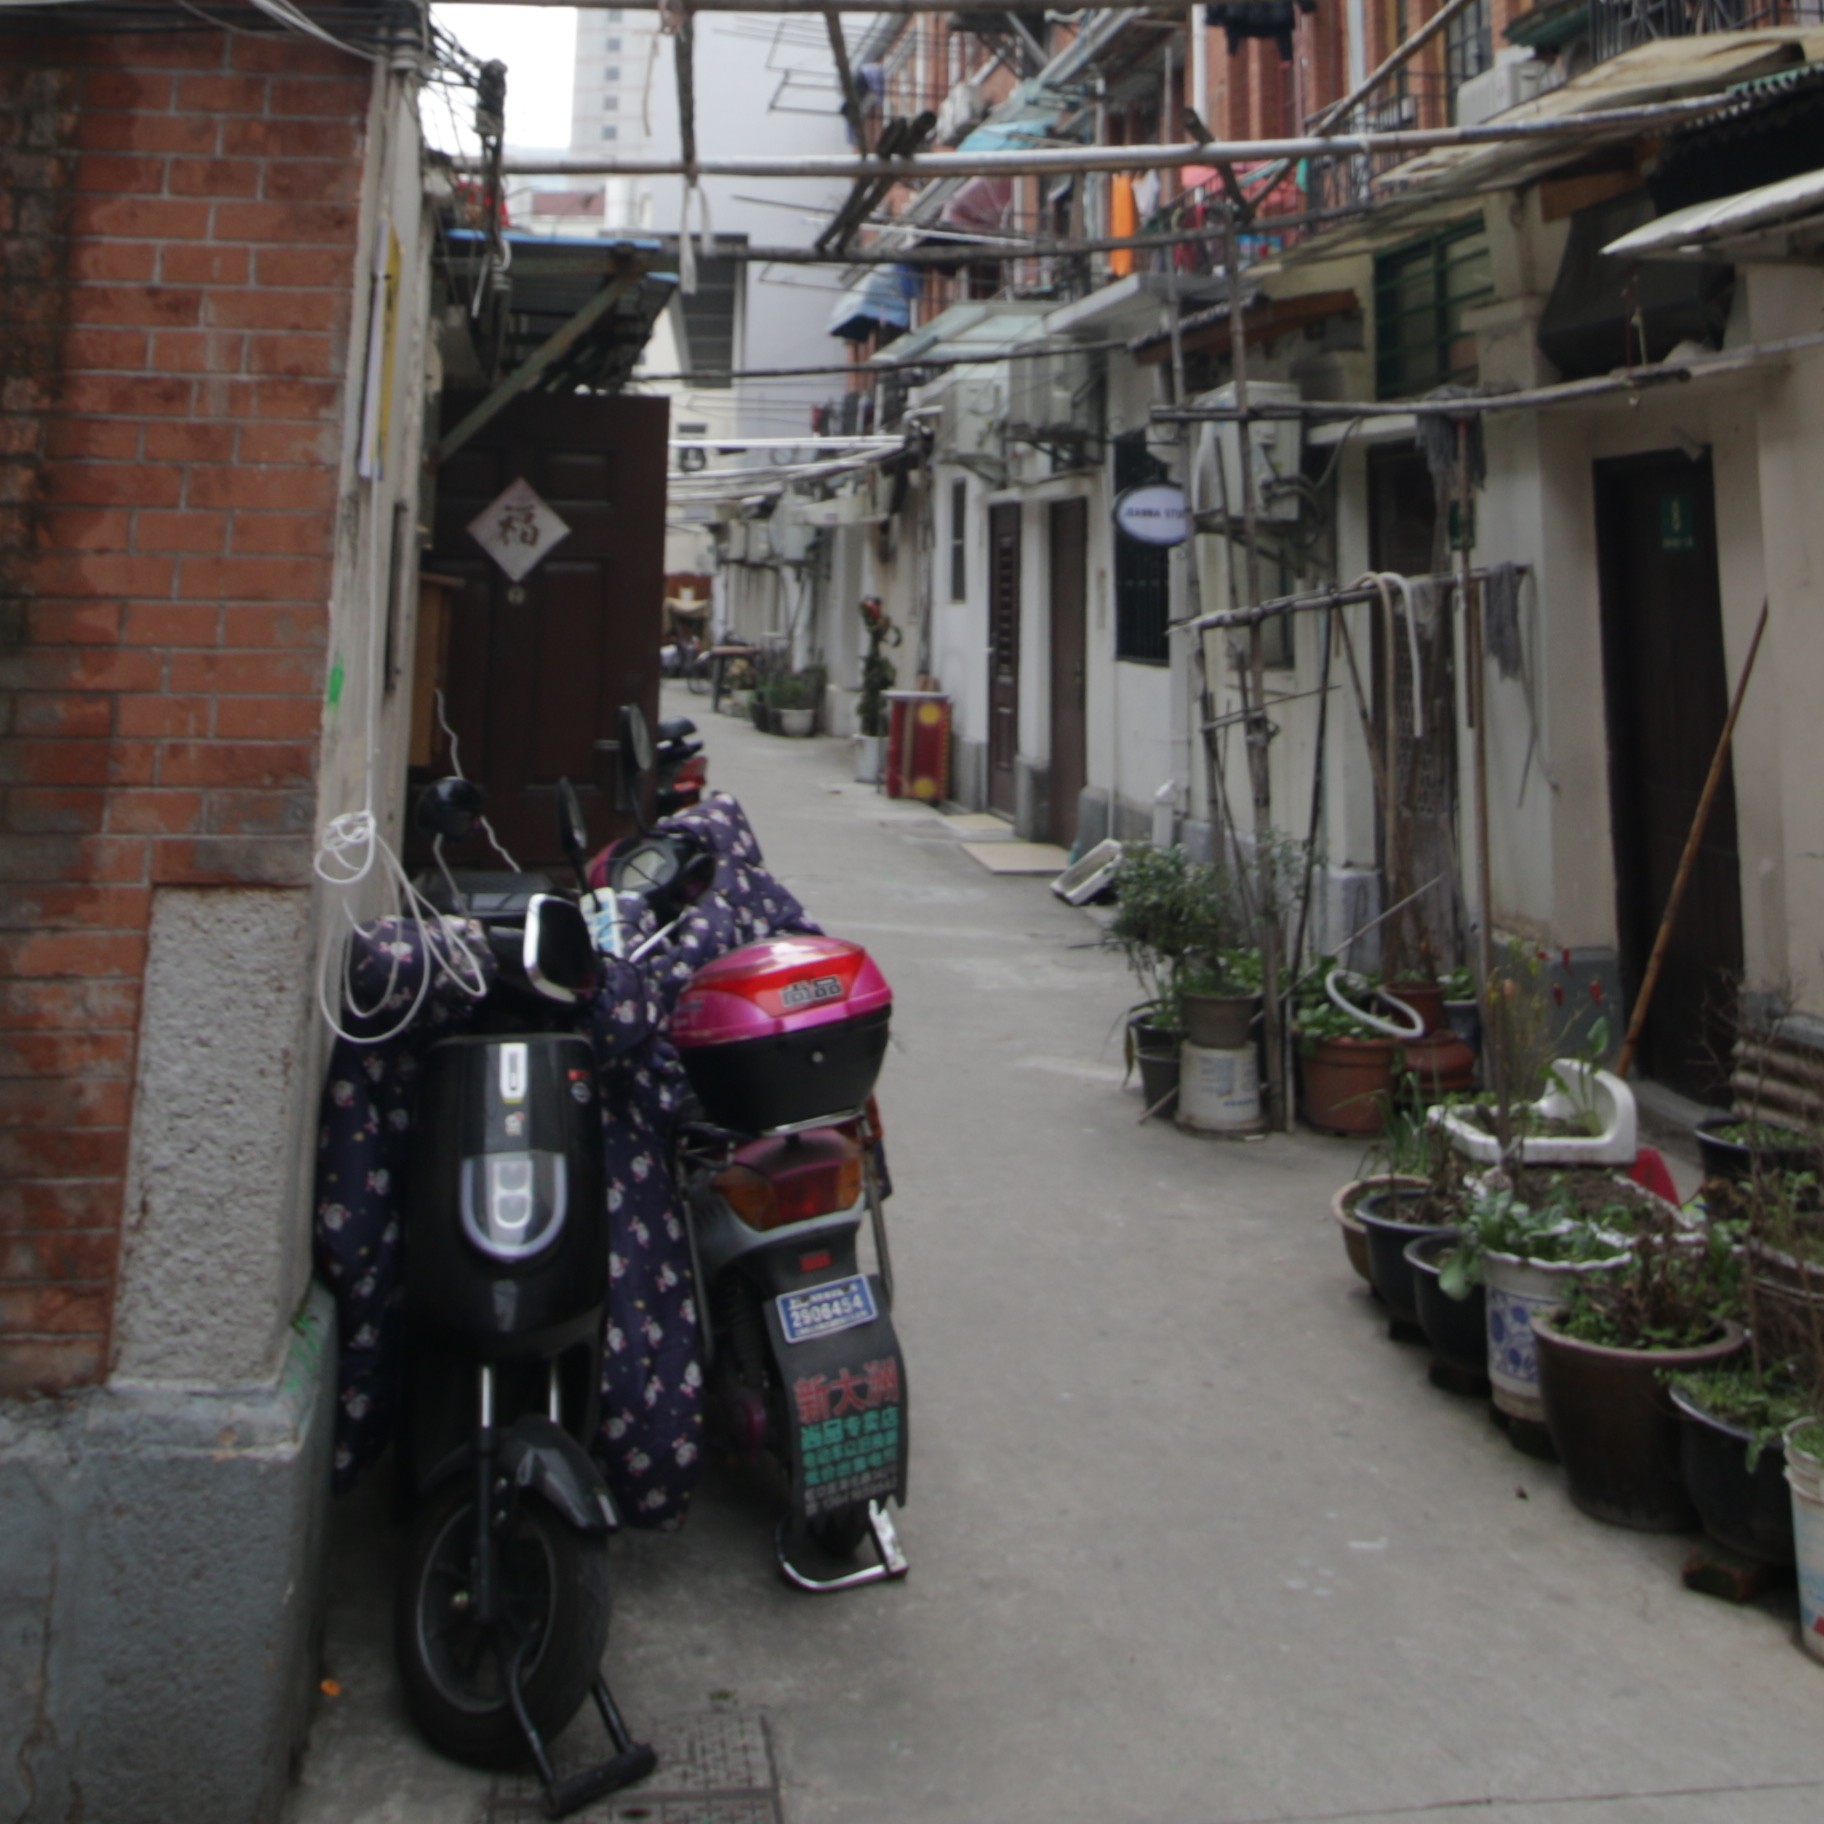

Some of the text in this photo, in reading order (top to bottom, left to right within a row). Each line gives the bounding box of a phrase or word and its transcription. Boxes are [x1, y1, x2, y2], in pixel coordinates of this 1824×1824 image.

[497, 503, 540, 547] 福
[780, 975, 844, 1008] 尚品
[793, 1357, 900, 1424] 新大洲
[800, 1406, 899, 1452] 尚品专卖店
